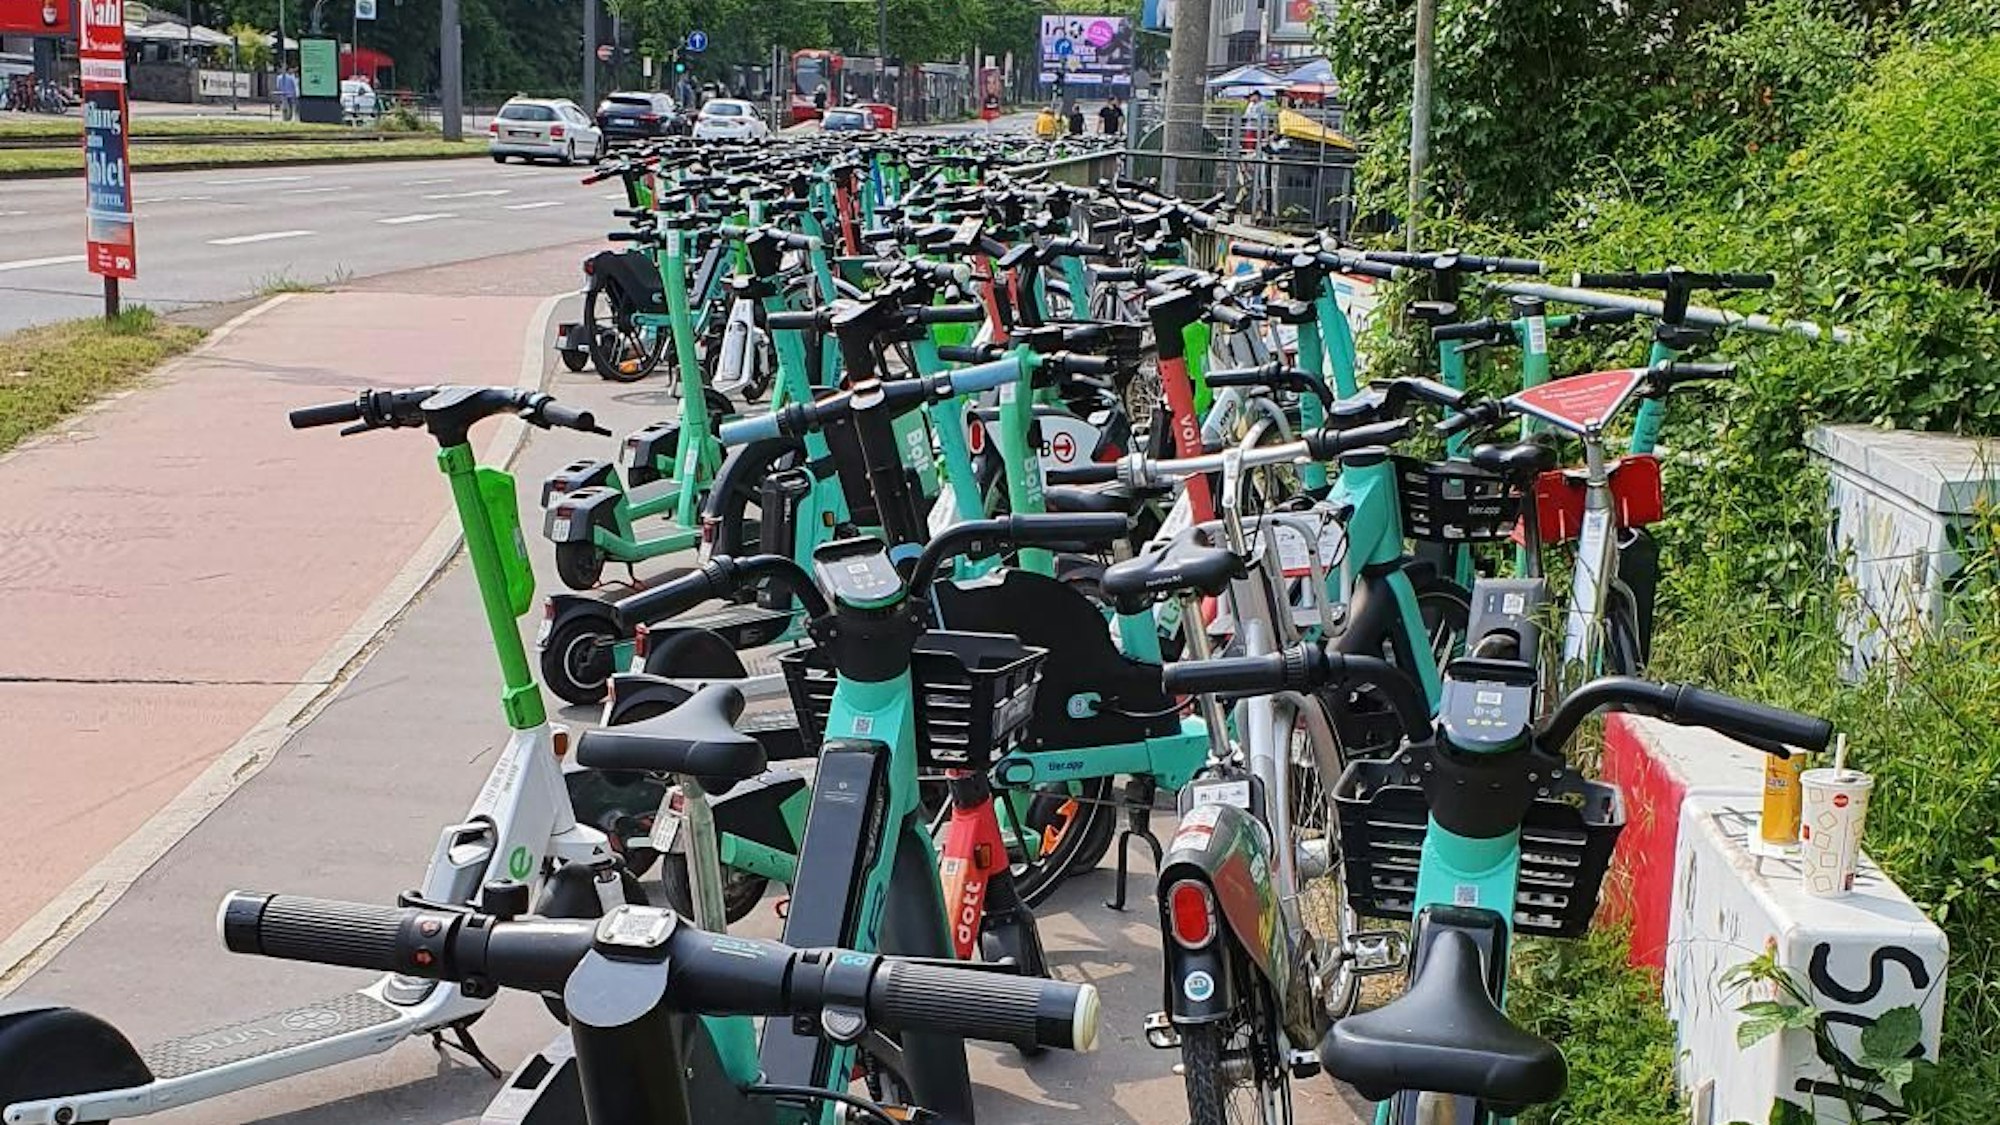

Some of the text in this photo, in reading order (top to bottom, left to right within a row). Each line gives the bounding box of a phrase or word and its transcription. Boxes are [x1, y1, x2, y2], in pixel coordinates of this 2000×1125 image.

[906, 427, 929, 474] Bolt
[1023, 457, 1042, 505] Bolt
[1047, 760, 1084, 773] tier.app
[957, 880, 982, 945] dott
